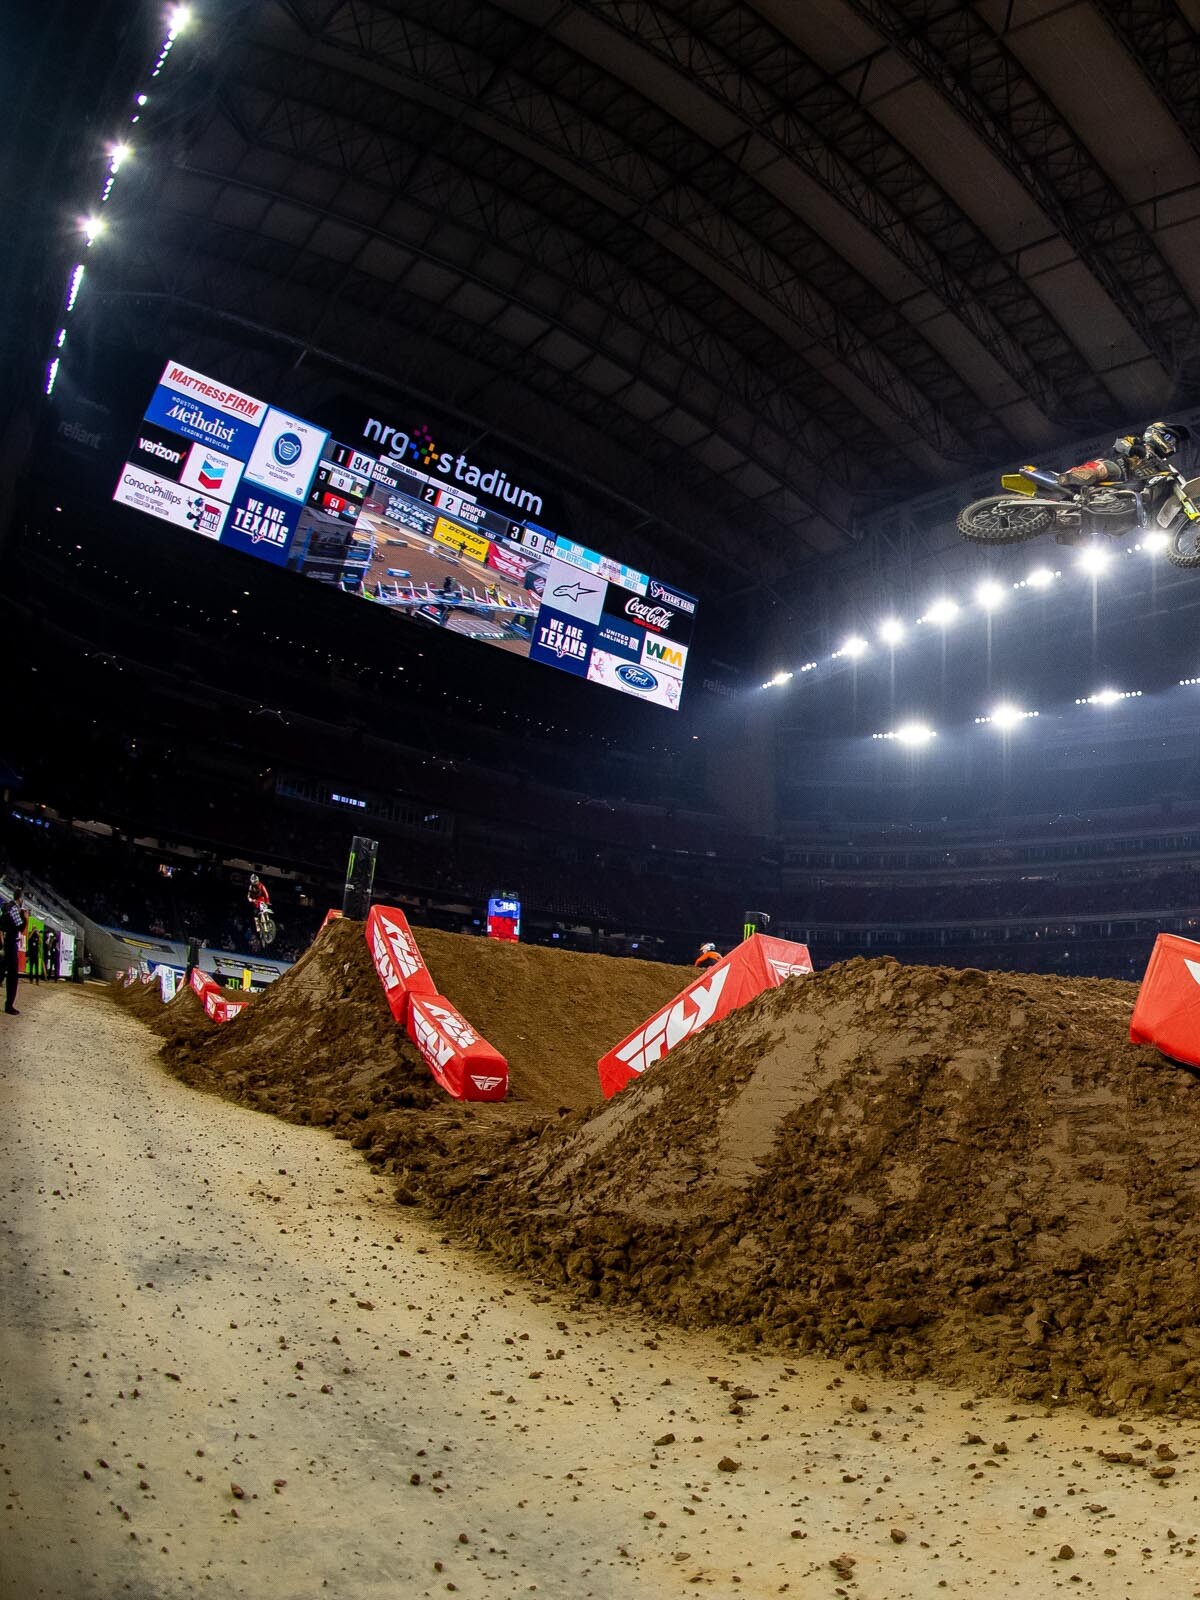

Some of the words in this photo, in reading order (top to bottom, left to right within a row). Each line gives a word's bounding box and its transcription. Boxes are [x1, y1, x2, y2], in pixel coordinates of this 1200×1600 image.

[171, 396, 200, 411] HOUSTON
[165, 404, 237, 443] Methodist
[180, 425, 203, 440] LEADING
[138, 437, 181, 464] verizon
[336, 449, 345, 463] 1
[353, 455, 371, 474] 94
[319, 470, 326, 480] 3
[363, 418, 410, 459] nrg
[436, 452, 543, 516] stadium
[374, 463, 389, 475] KEN
[123, 474, 182, 505] ConocoPhillips
[338, 478, 345, 488] 9
[371, 472, 398, 488] ROCZEN
[248, 497, 264, 514] WE
[264, 503, 286, 522] ARE
[329, 497, 340, 509] 51
[424, 489, 434, 503] 2
[444, 498, 456, 511] 2
[461, 502, 487, 519] COOPER
[231, 508, 289, 544] TEXANS
[459, 510, 479, 524] WEBB
[444, 535, 482, 557] DULOP
[447, 524, 487, 546] DUNLOP
[510, 525, 519, 539] 3
[531, 535, 540, 548] 9
[550, 618, 565, 631] WE
[565, 624, 583, 641] ARE
[599, 632, 628, 647] AIRLINES
[605, 628, 629, 641] UNITED
[540, 627, 588, 658] TEXANS
[646, 639, 683, 667] WM
[625, 668, 649, 686] Ford
[381, 915, 419, 978] FLY
[615, 963, 730, 1073] FLY
[413, 1006, 456, 1067] FLY
